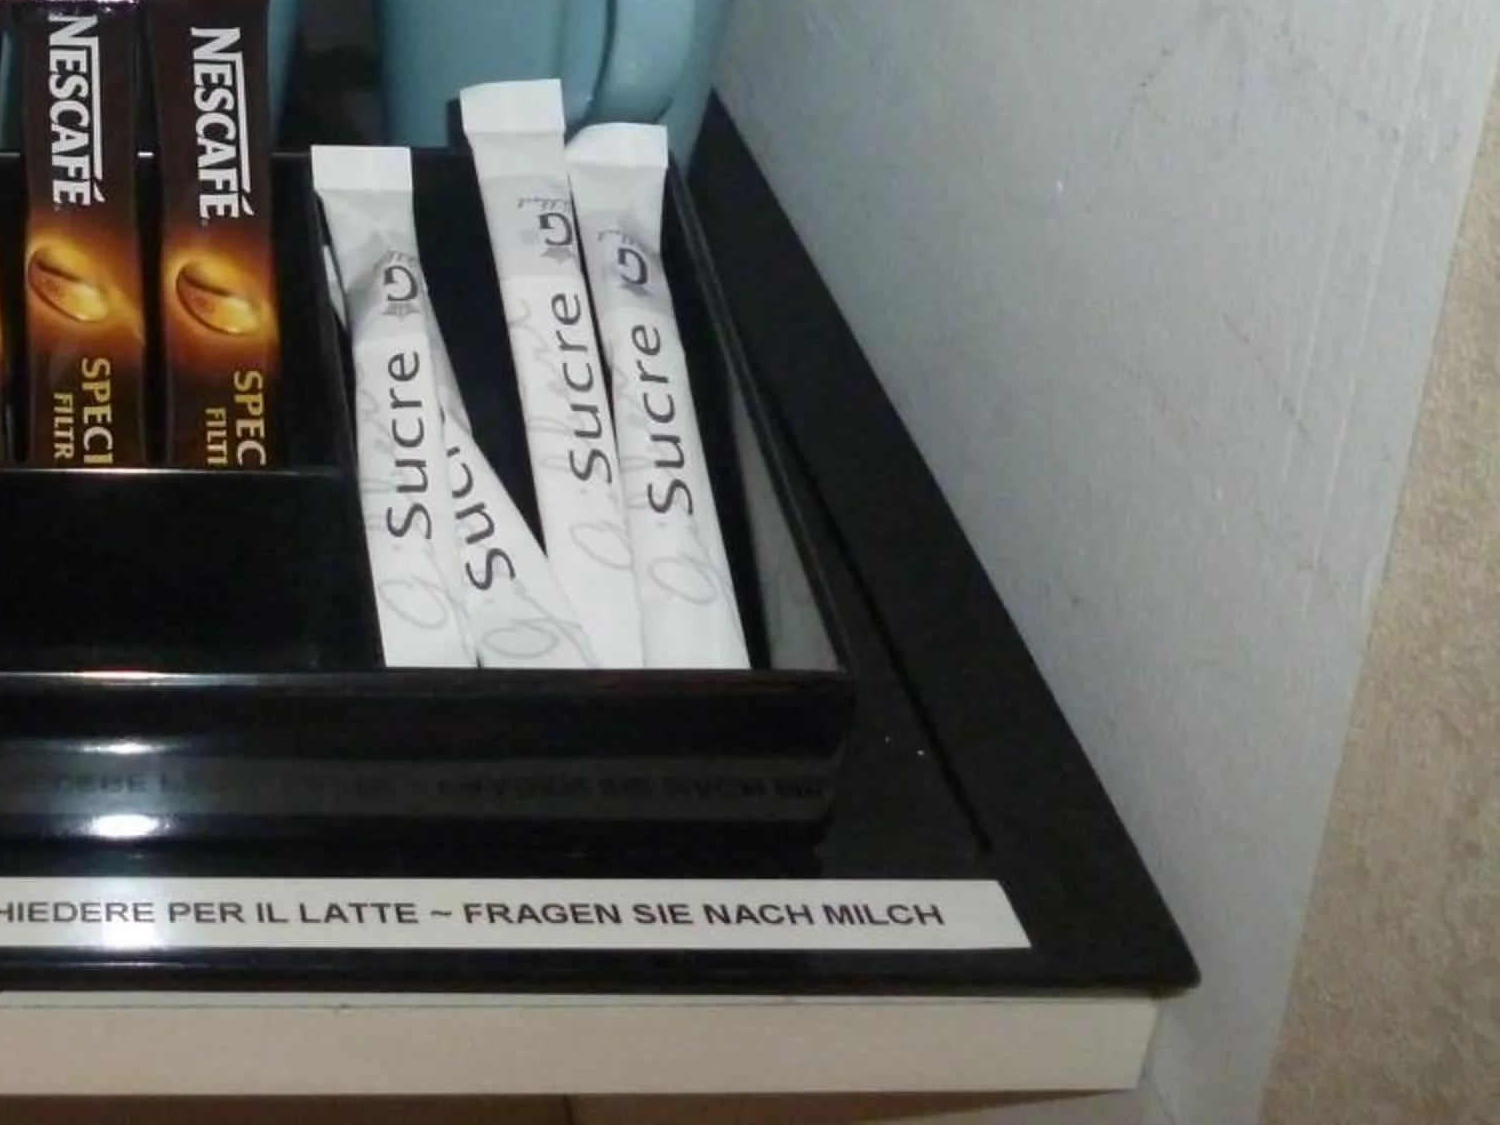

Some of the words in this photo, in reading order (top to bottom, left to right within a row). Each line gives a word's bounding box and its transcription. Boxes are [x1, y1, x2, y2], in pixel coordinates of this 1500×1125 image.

[47, 14, 106, 207] NESCAFÉ
[189, 26, 256, 220] NESCAFÉ
[53, 391, 75, 461] FILTR
[81, 356, 114, 464] SPECI
[232, 369, 267, 466] SPEC
[386, 351, 432, 540] Sucre
[550, 292, 613, 484] Sucre
[631, 323, 694, 516] Sucre
[446, 443, 517, 591] Suc
[168, 900, 246, 925] PER
[256, 900, 289, 925] IL
[298, 900, 419, 925] LATTE
[462, 900, 623, 925] FRAGEN
[631, 900, 694, 925] SIE
[701, 900, 815, 925] NACH
[821, 900, 945, 925] MILCH
